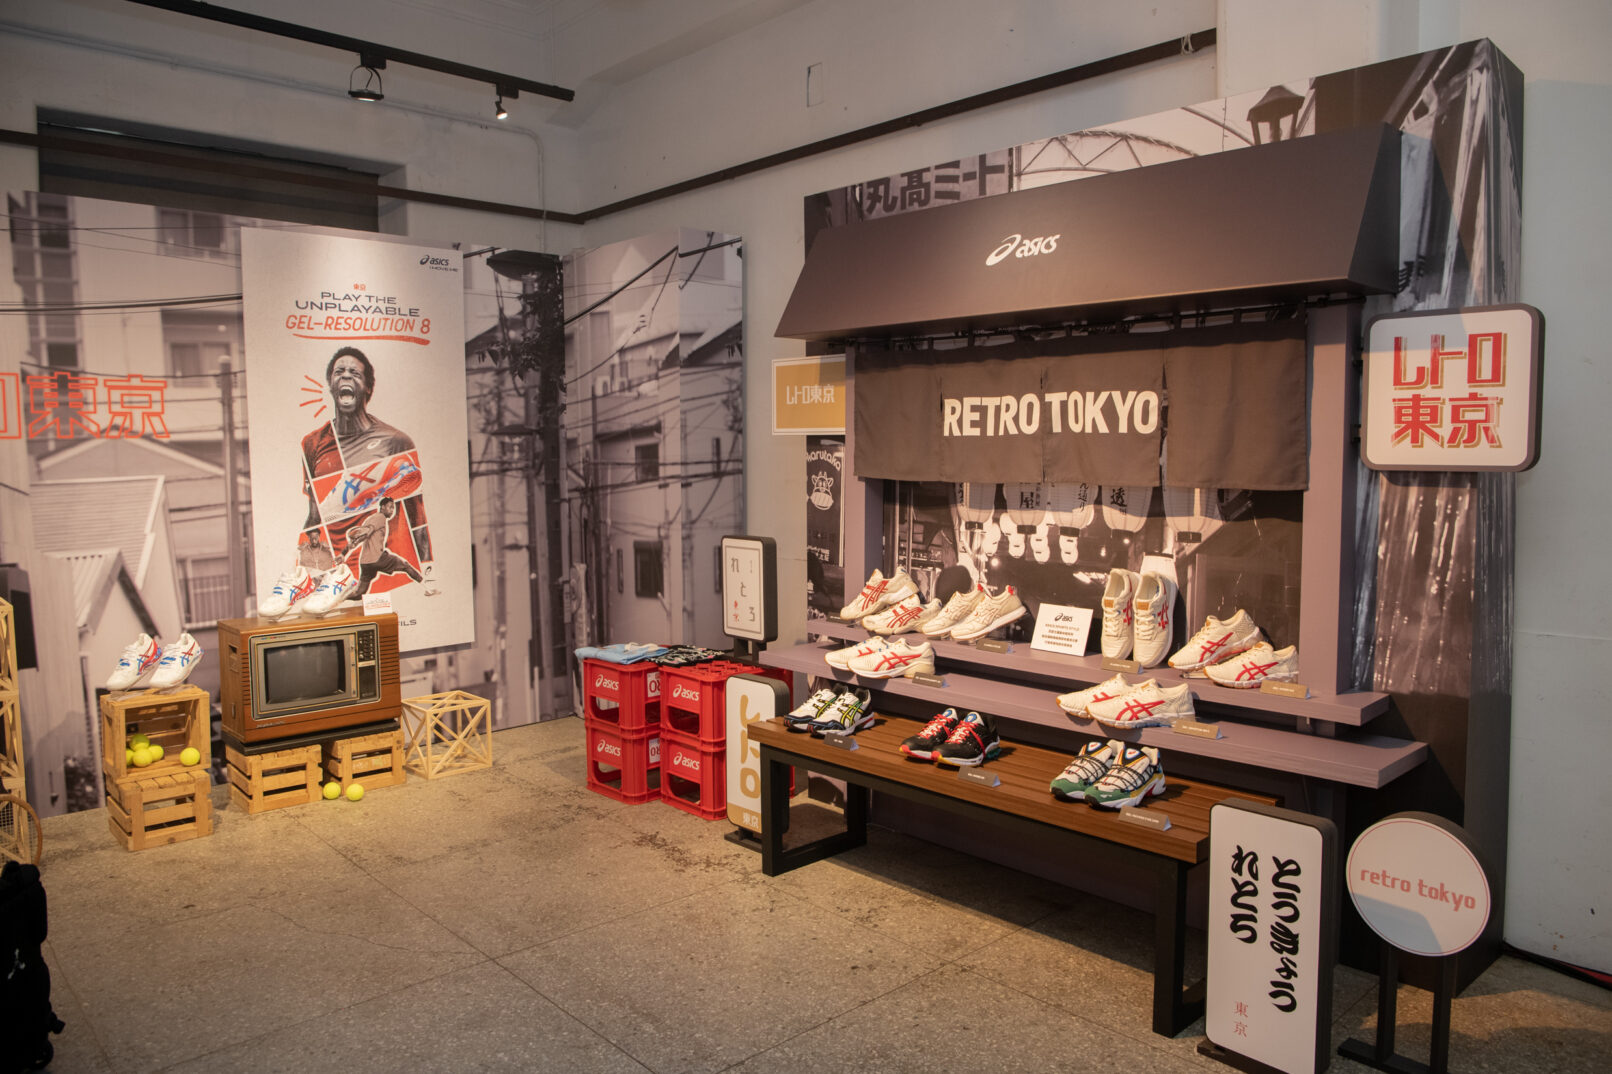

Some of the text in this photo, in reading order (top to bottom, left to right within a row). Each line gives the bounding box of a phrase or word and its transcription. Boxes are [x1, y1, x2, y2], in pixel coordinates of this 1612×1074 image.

[1015, 234, 1061, 259] asics
[429, 256, 449, 266] asics
[321, 292, 397, 305] PLAY THE
[295, 300, 420, 317] UNPLAYABLE
[420, 318, 431, 334] 8
[1393, 332, 1508, 390] レトロ
[786, 384, 835, 405] レトロ東京
[943, 390, 1159, 437] RETRO TOKYO
[1391, 392, 1504, 449] 東京
[602, 677, 620, 691] asics
[680, 688, 700, 702] asics
[604, 743, 622, 757] asics
[681, 756, 701, 770] asics
[743, 812, 759, 830] 東京
[1360, 866, 1476, 912] retro tokyo
[1233, 1001, 1249, 1038] 東京
